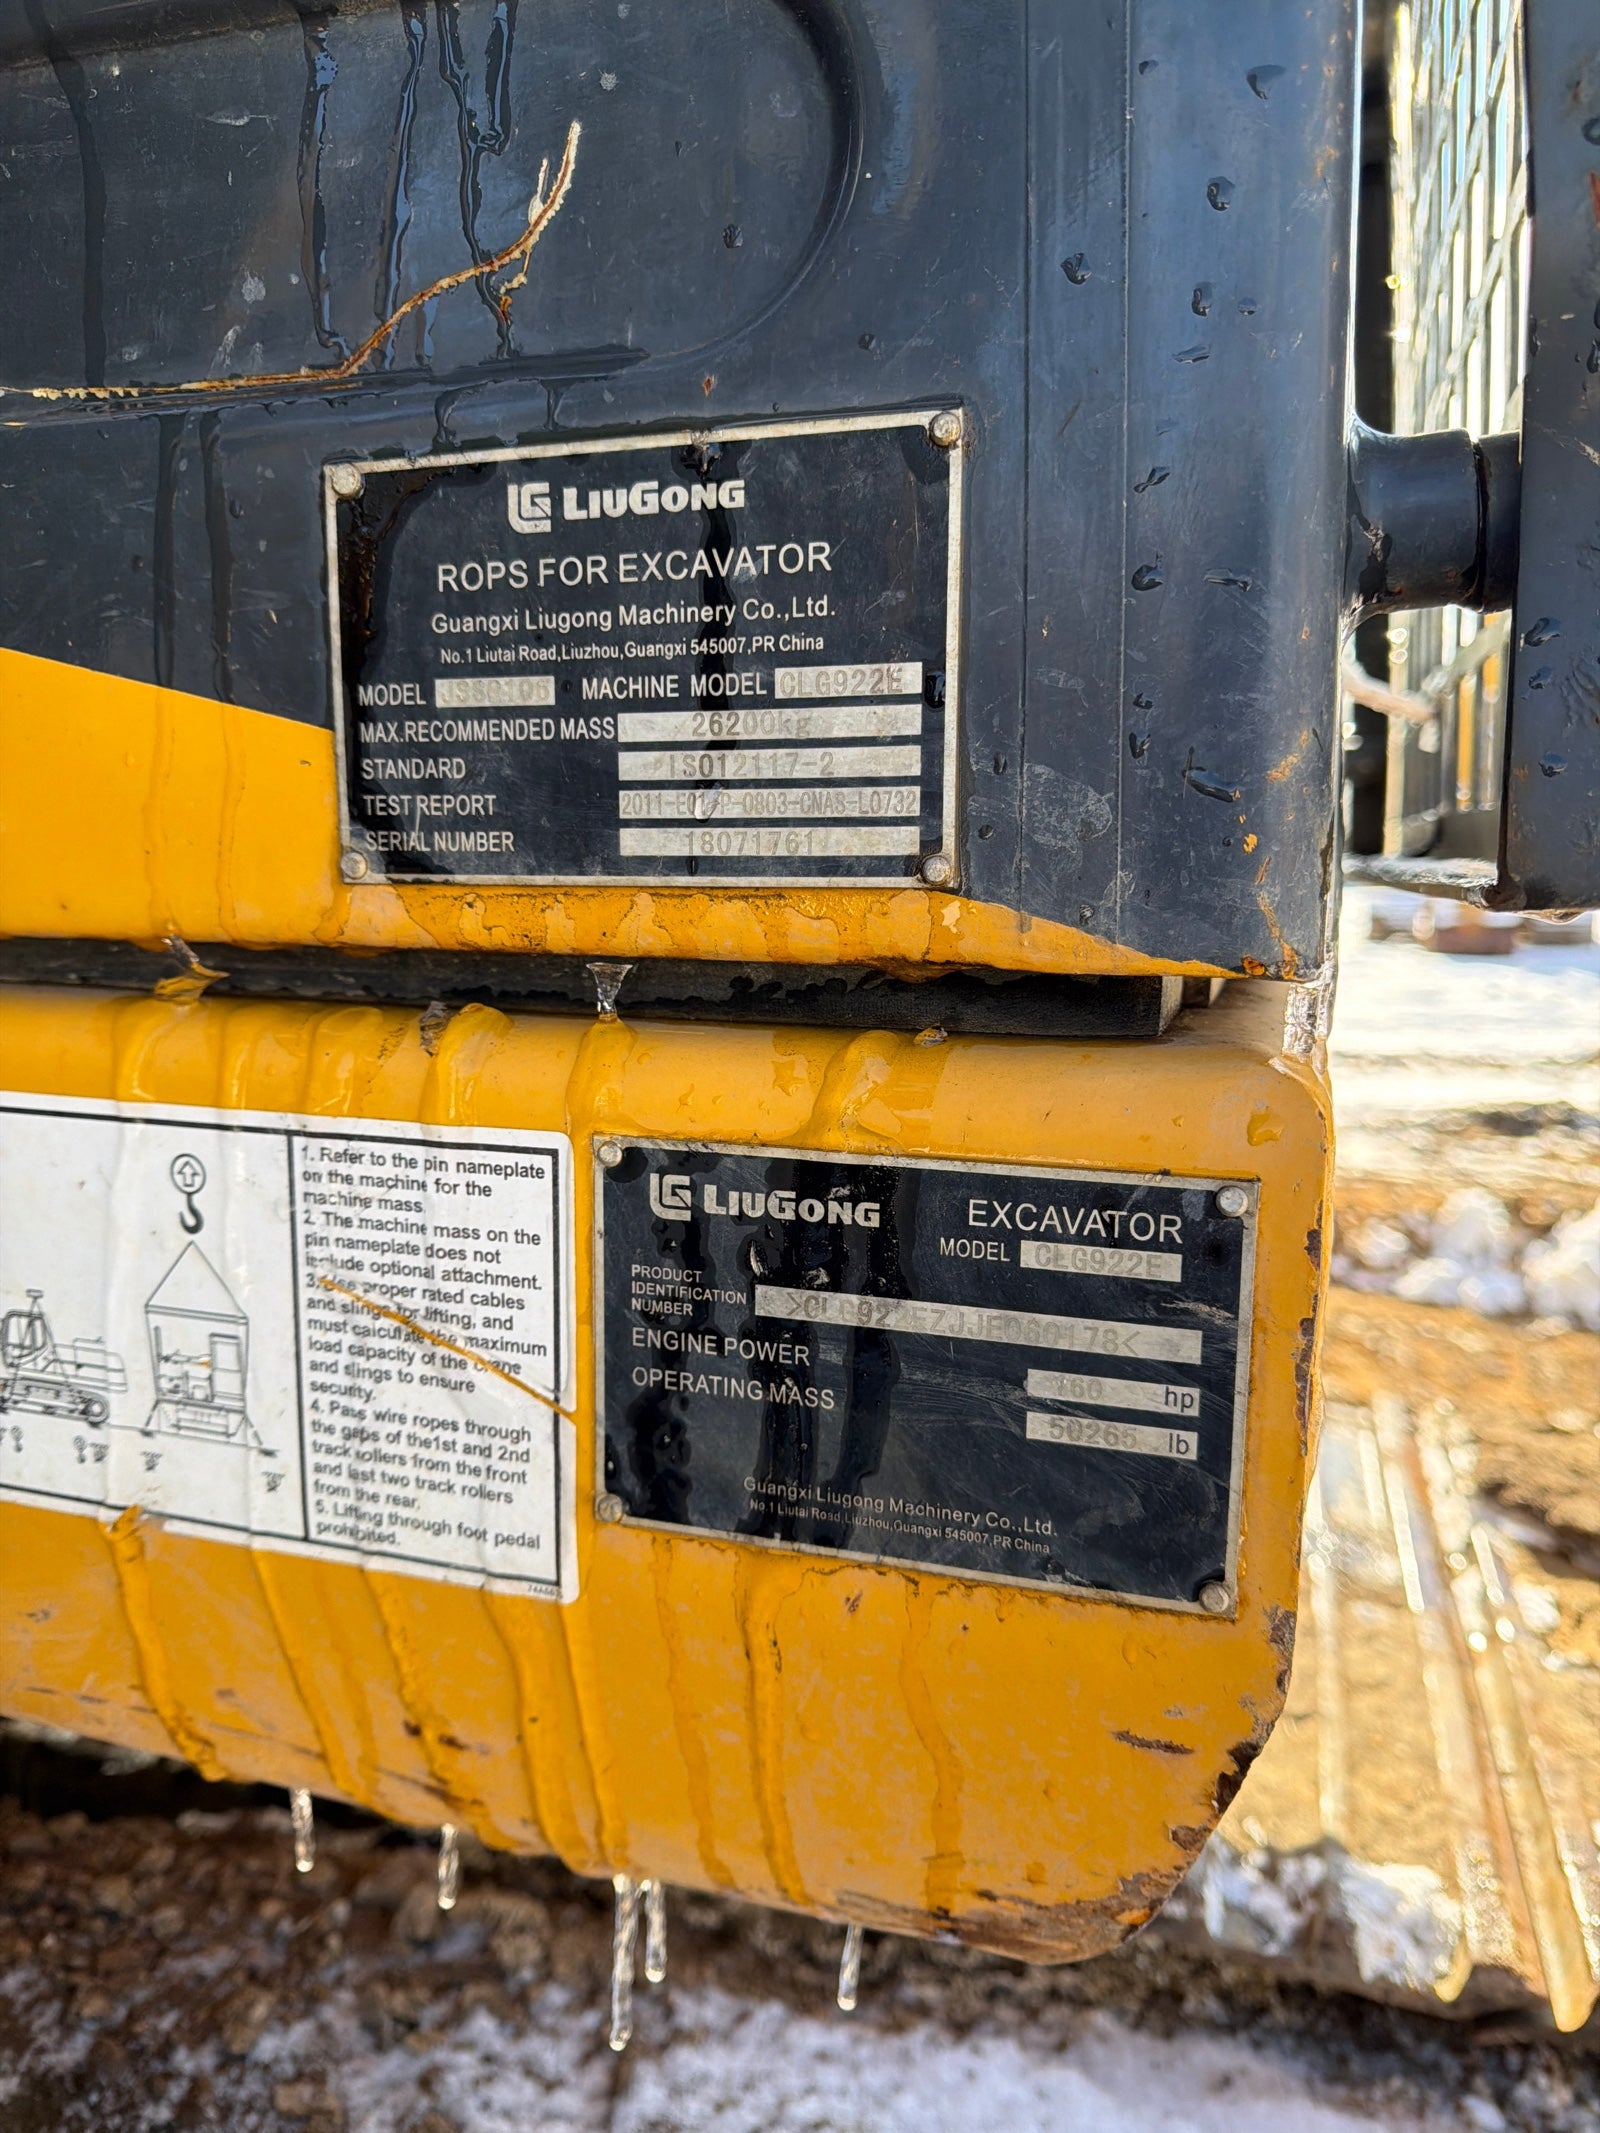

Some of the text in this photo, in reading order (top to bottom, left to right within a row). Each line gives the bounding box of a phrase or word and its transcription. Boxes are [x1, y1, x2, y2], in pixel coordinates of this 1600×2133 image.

[438, 542, 832, 592] ROPS FOR EXCAVATOR
[431, 595, 835, 636] Guangxi Liugong Machinery Co.,Ltd.
[441, 647, 472, 664] No.1
[476, 645, 515, 662] Liutai
[690, 636, 775, 656] 545007,PR
[779, 632, 824, 651] China
[358, 683, 426, 706] MODEL
[582, 675, 679, 700] MACHINE
[691, 672, 767, 698] MODEL
[779, 667, 903, 697] CLG922E
[360, 718, 555, 743] MAX.RECOMMENDED
[560, 717, 615, 740] MASS
[361, 758, 466, 780] STANDARD
[363, 795, 412, 817] TEST
[417, 794, 496, 816] REPORT
[366, 831, 814, 856] SERIAL NUMBER 18071761
[319, 1147, 366, 1165] Refer
[370, 1152, 387, 1167] to
[392, 1153, 418, 1169] the
[424, 1156, 449, 1175] pin
[456, 1160, 545, 1180] nameplate
[303, 1169, 492, 1197] on the machine for the
[303, 1190, 372, 1209] machine
[322, 1211, 354, 1228] The
[359, 1217, 428, 1236] machine
[433, 1224, 481, 1240] mass
[486, 1229, 509, 1244] on
[514, 1229, 541, 1246] the
[968, 1199, 1183, 1244] EXCAVATOR
[305, 1232, 502, 1264] pin nameplate does not
[940, 1237, 1162, 1279] MODEL CLG922E
[305, 1251, 542, 1290] inlude optional attachment.
[631, 1264, 702, 1283] PRODUCT
[363, 1281, 417, 1299] proper
[422, 1287, 464, 1304] rated
[470, 1291, 526, 1310] cables
[631, 1281, 747, 1305] IDENTIFICATION
[631, 1298, 693, 1316] NUMBER
[307, 1295, 335, 1310] and
[424, 1305, 477, 1330] lifting,
[482, 1315, 514, 1331] and
[307, 1317, 348, 1334] must
[463, 1333, 547, 1357] maximum
[308, 1335, 342, 1352] load
[348, 1342, 415, 1366] capacity
[421, 1351, 437, 1367] of
[441, 1354, 468, 1370] the
[310, 1359, 476, 1393] and slings to ensure
[632, 1327, 717, 1356] ENGINE
[725, 1338, 810, 1367] POWER
[1165, 1386, 1194, 1413] hp
[374, 1407, 408, 1425] wire
[413, 1414, 460, 1433] ropes
[465, 1418, 532, 1444] through
[632, 1366, 763, 1400] OPERATING
[770, 1383, 835, 1410] MASS
[1168, 1433, 1189, 1455] lb
[311, 1419, 336, 1435] the
[341, 1425, 380, 1445] gaps
[386, 1429, 402, 1445] of
[462, 1442, 492, 1458] and
[498, 1445, 531, 1463] 2nd
[312, 1439, 352, 1457] track
[412, 1453, 451, 1473] from
[455, 1460, 482, 1477] the
[486, 1464, 528, 1485] front
[313, 1478, 350, 1497] from
[355, 1486, 381, 1503] the
[314, 1461, 514, 1504] and last two track rollers
[744, 1476, 1058, 1537] Guangxi Liugong Machinery Co.,Ltd.
[316, 1520, 401, 1546] prohibited.
[333, 1501, 384, 1527] Lifting
[388, 1511, 452, 1537] through
[456, 1521, 488, 1542] foot
[494, 1531, 541, 1550] pedal
[778, 1503, 809, 1519] Liutai
[1014, 1537, 1050, 1554] China
